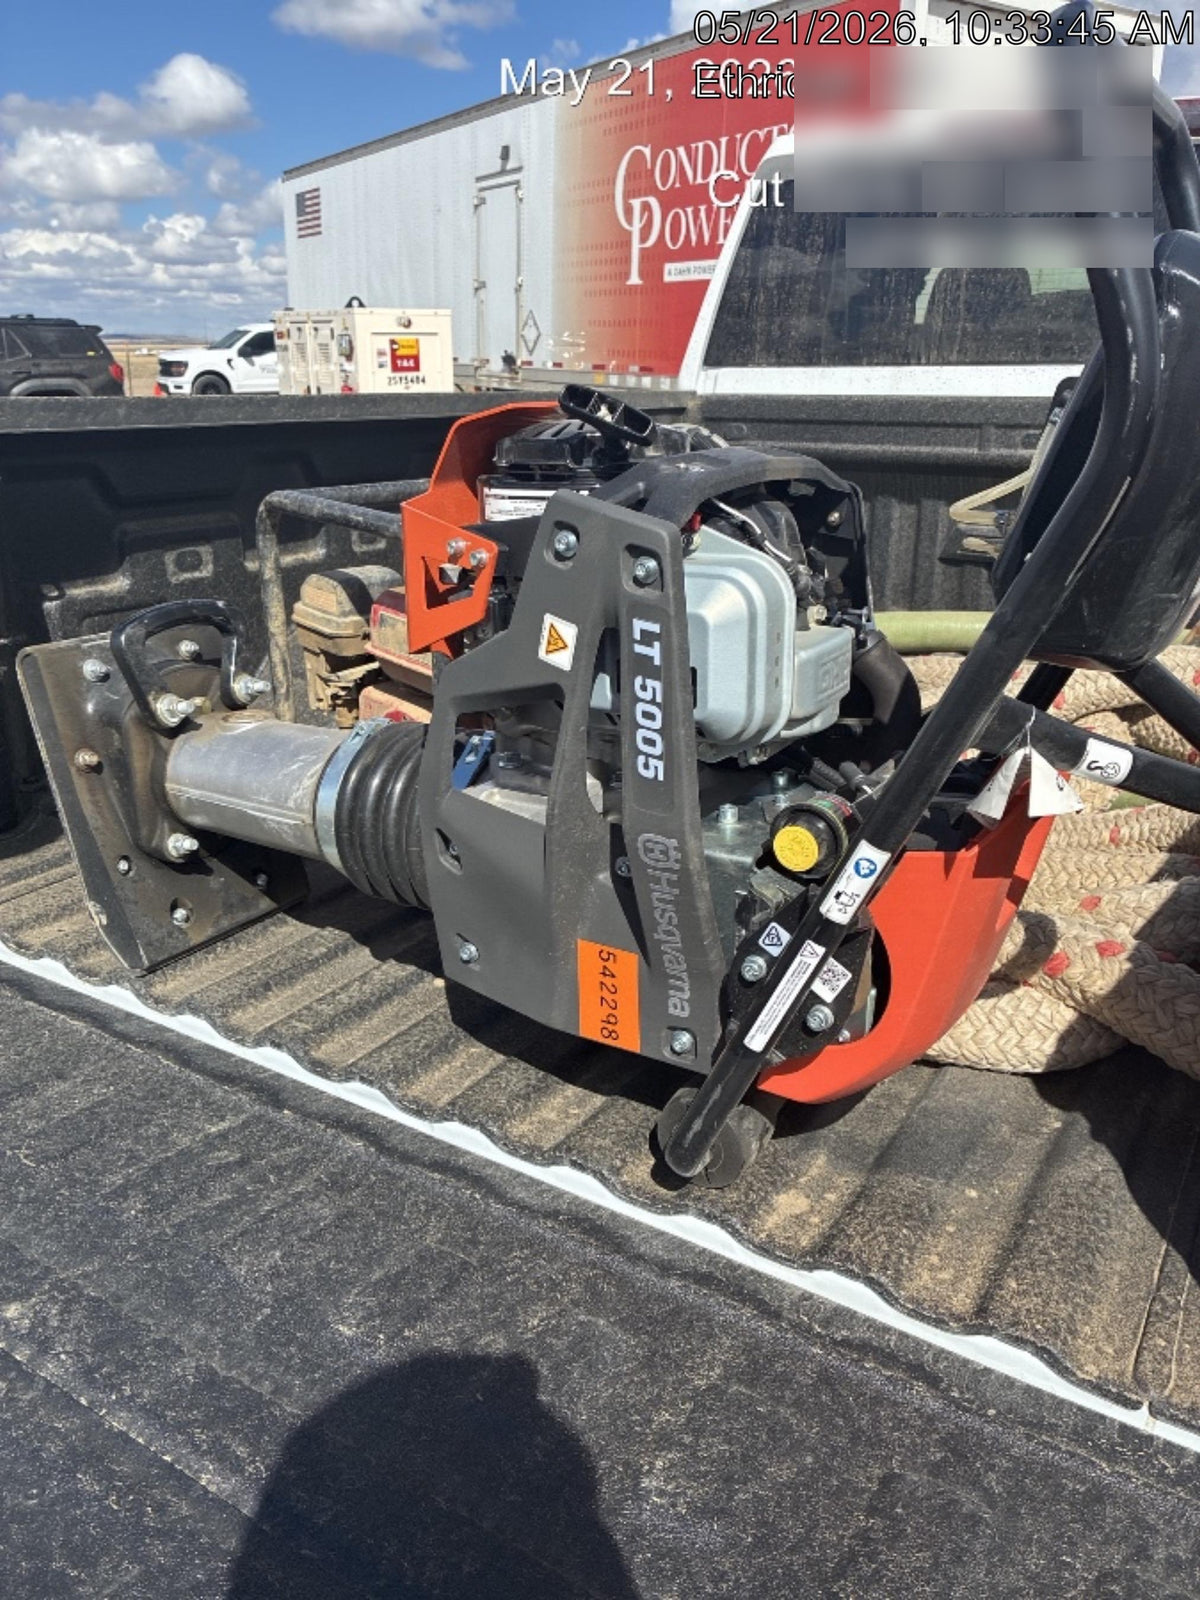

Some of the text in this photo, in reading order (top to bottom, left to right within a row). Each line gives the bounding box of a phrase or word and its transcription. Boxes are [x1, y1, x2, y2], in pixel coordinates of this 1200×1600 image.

[632, 617, 665, 782] LT 5005
[598, 949, 621, 1042] 542298
[647, 868, 692, 1019] Husqvarna
